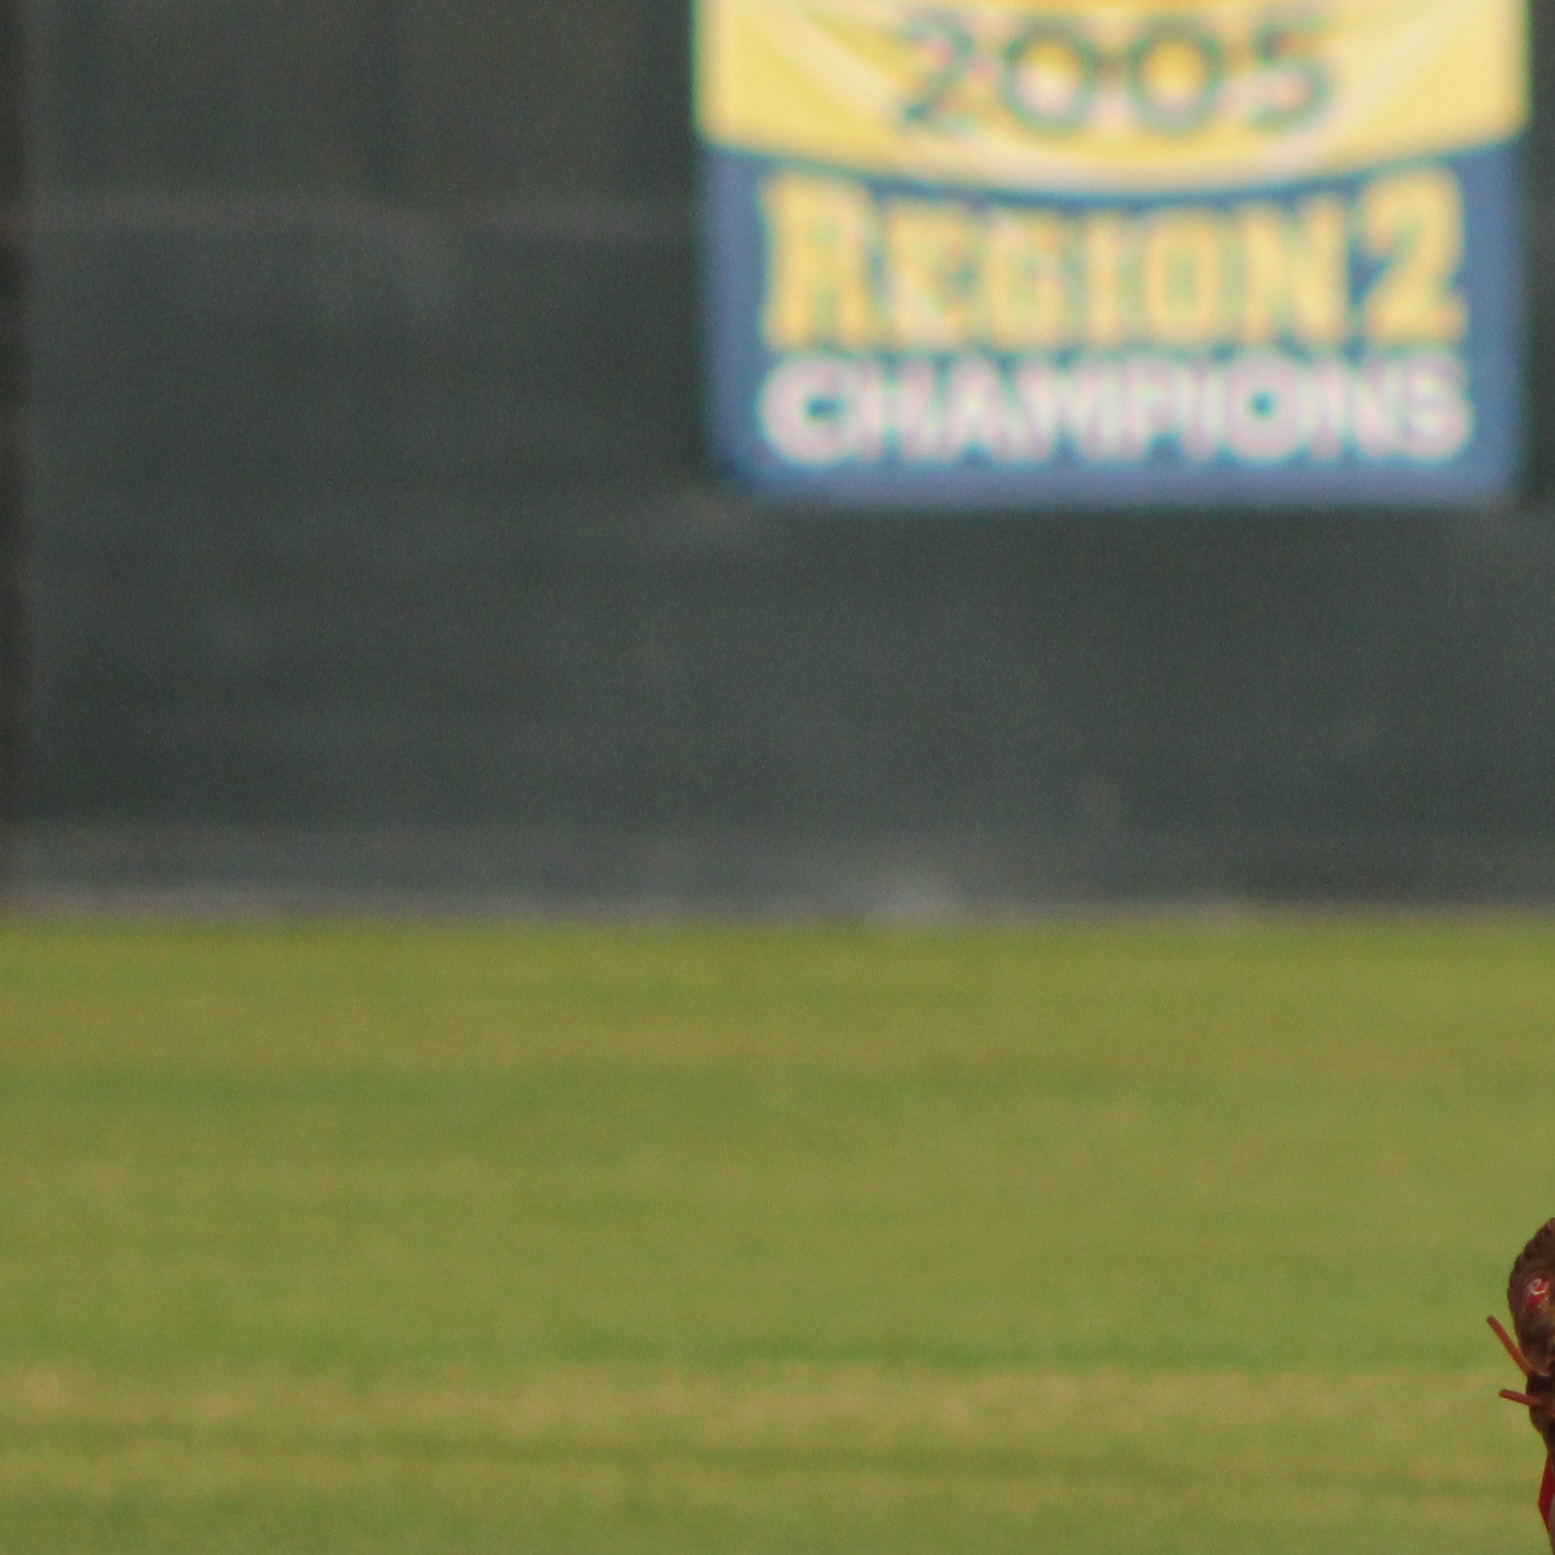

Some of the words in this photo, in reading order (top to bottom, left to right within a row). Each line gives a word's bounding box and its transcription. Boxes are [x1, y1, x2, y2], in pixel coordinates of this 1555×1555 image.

[895, 14, 1333, 134] 2005
[760, 170, 1349, 352] REGION
[1355, 166, 1471, 352] 2
[755, 350, 1475, 470] CHAMPIONS
